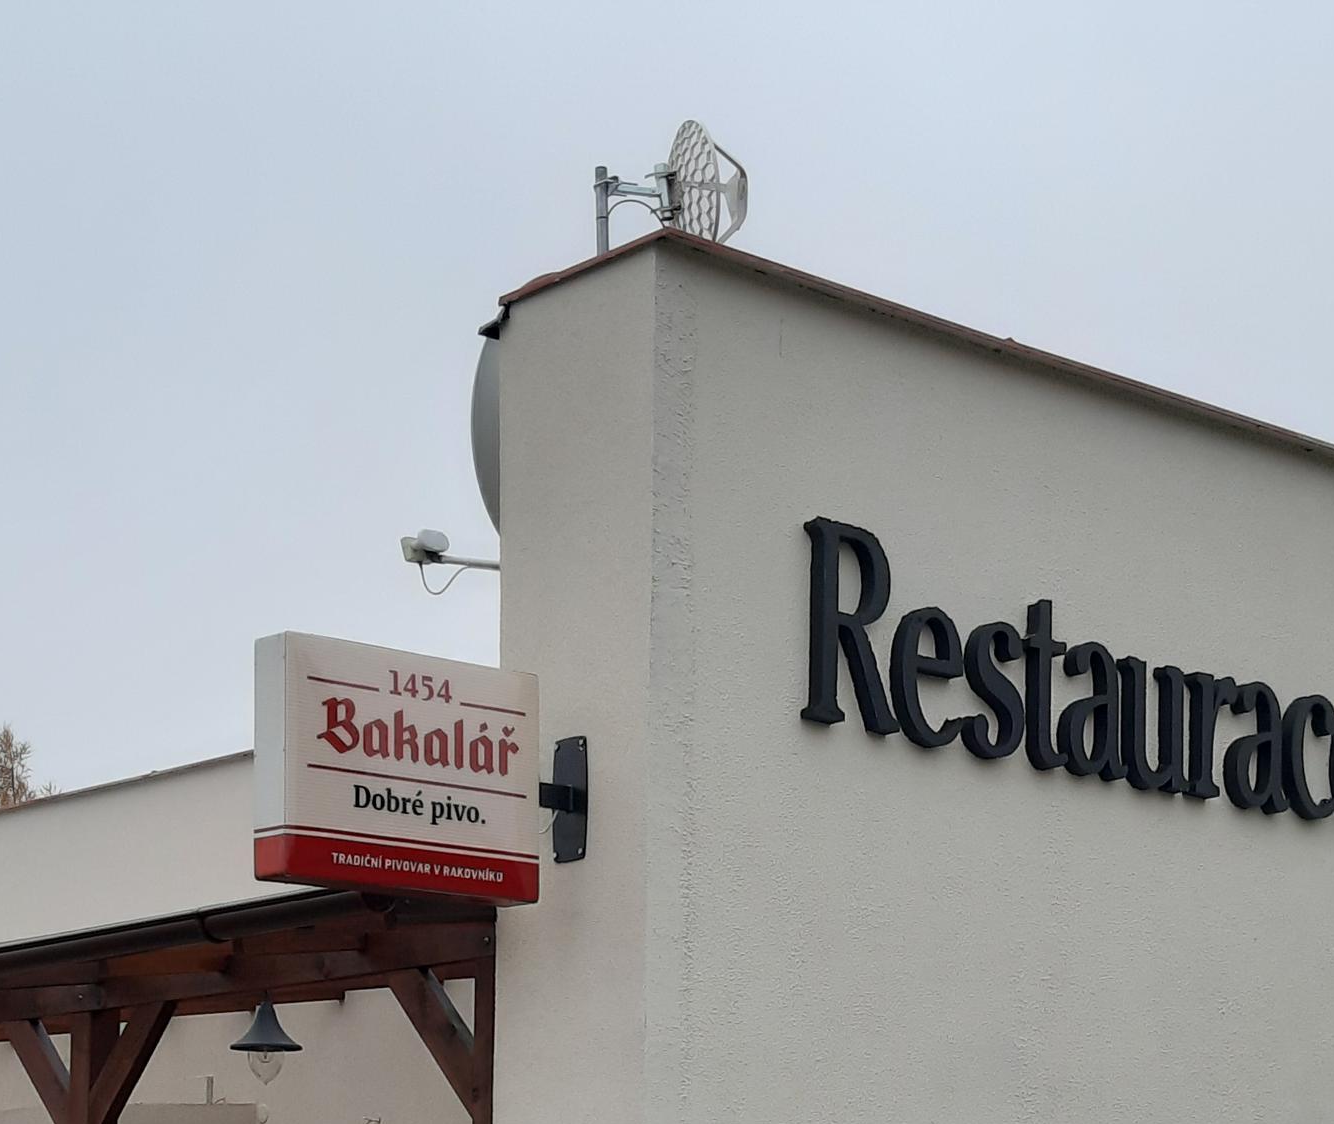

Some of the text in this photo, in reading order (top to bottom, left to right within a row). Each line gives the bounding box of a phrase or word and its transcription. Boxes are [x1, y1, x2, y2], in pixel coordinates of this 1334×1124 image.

[388, 669, 452, 703] 1454
[317, 697, 519, 777] Bakalář
[353, 784, 487, 825] Dobré pivo.
[331, 852, 504, 883] TRADIČNÍ PIVOVAR V RAKOVNÍKU
